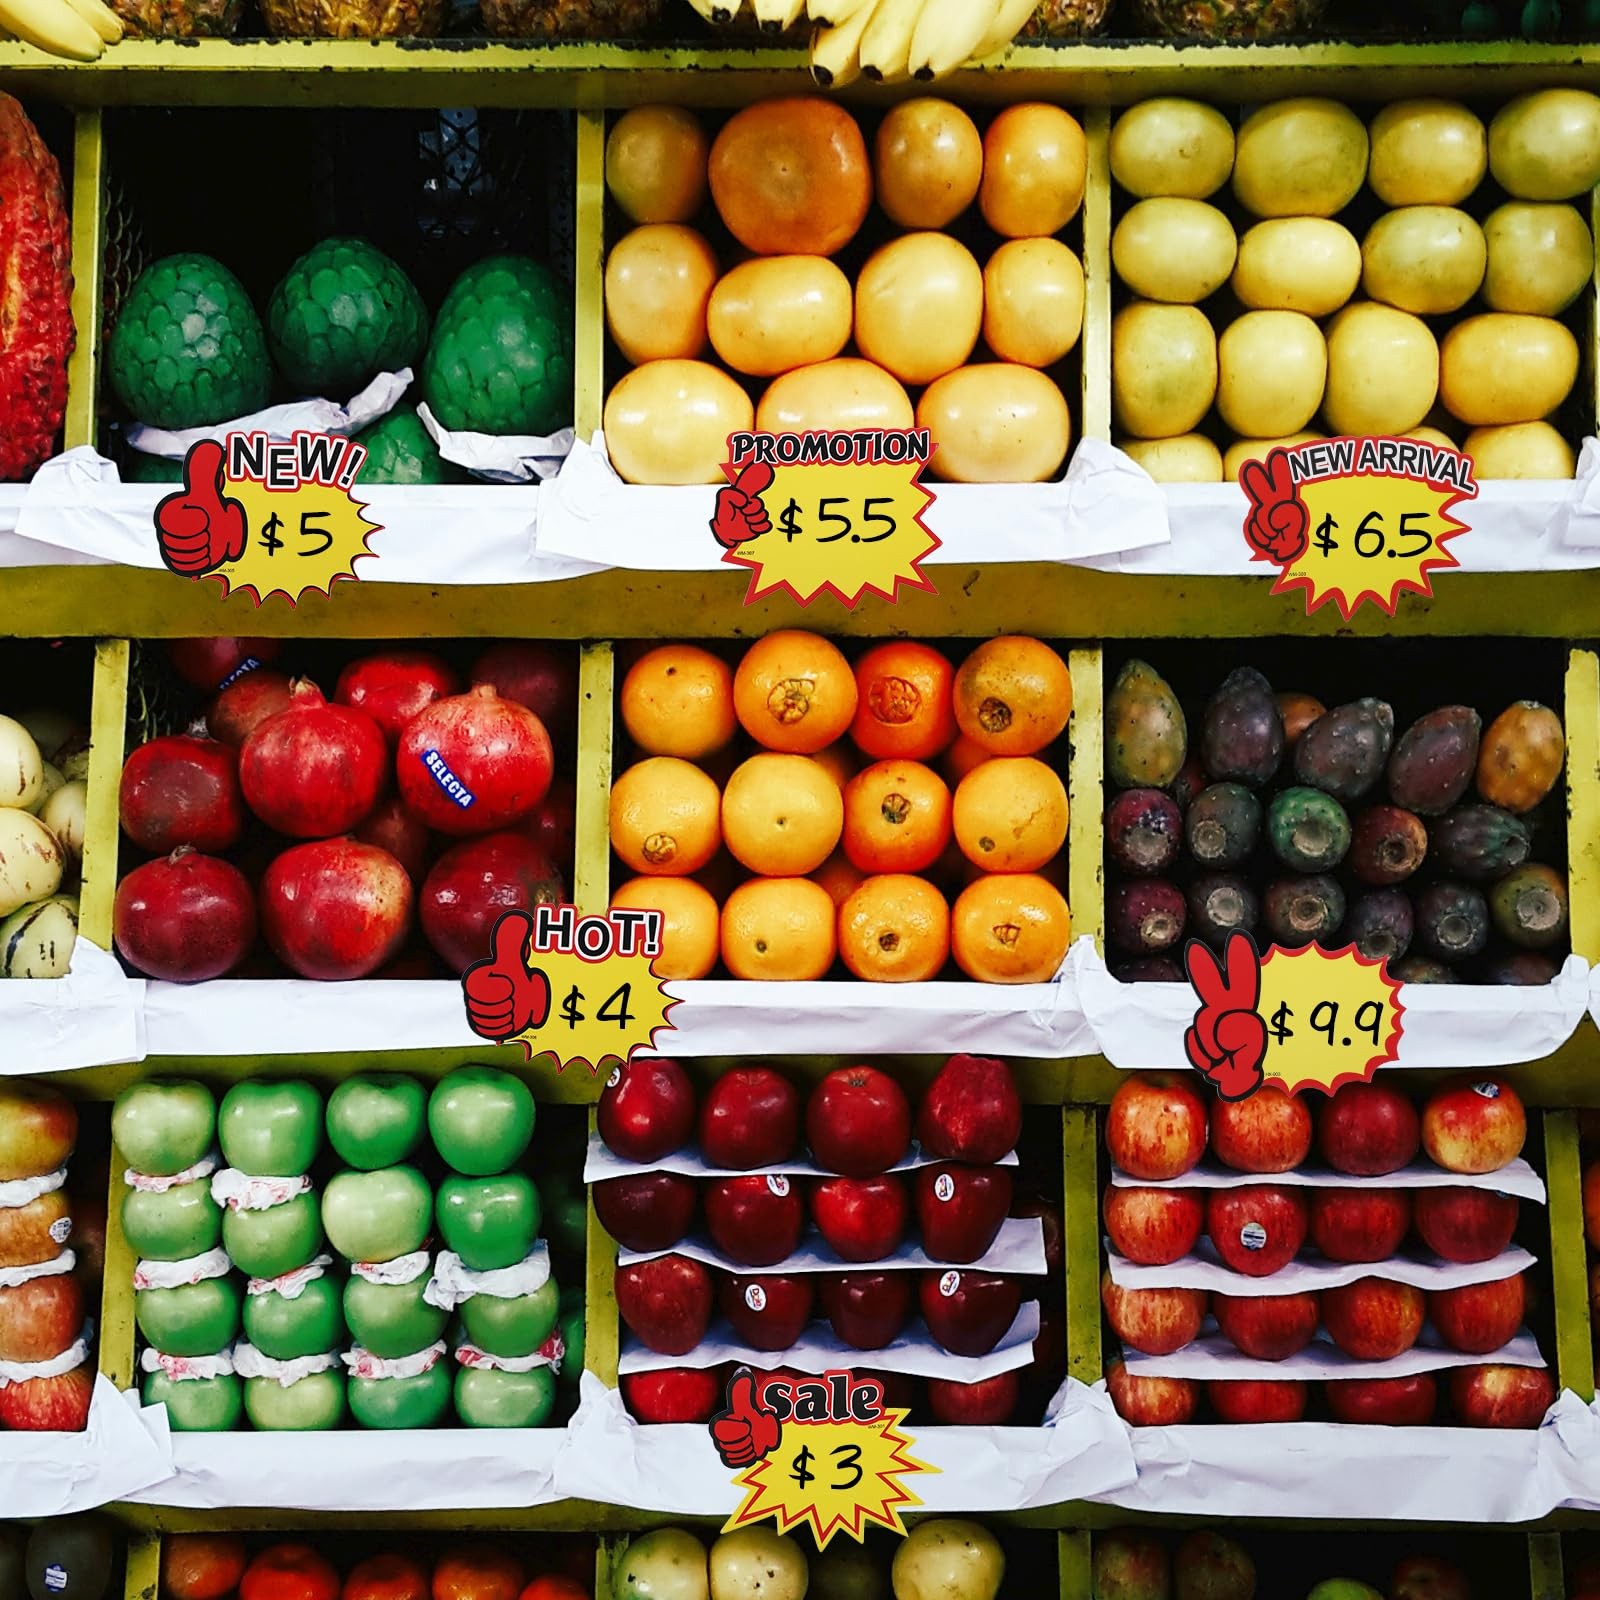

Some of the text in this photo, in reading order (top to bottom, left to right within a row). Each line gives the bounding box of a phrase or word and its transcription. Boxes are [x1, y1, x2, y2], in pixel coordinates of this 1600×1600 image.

[231, 433, 366, 488] NEW!
[732, 430, 929, 464] PROMOTION
[1289, 440, 1477, 495] NEW ARRIVAL
[426, 751, 472, 807] SELECTA
[536, 907, 661, 960] HOT!
[763, 1374, 881, 1422] sale
